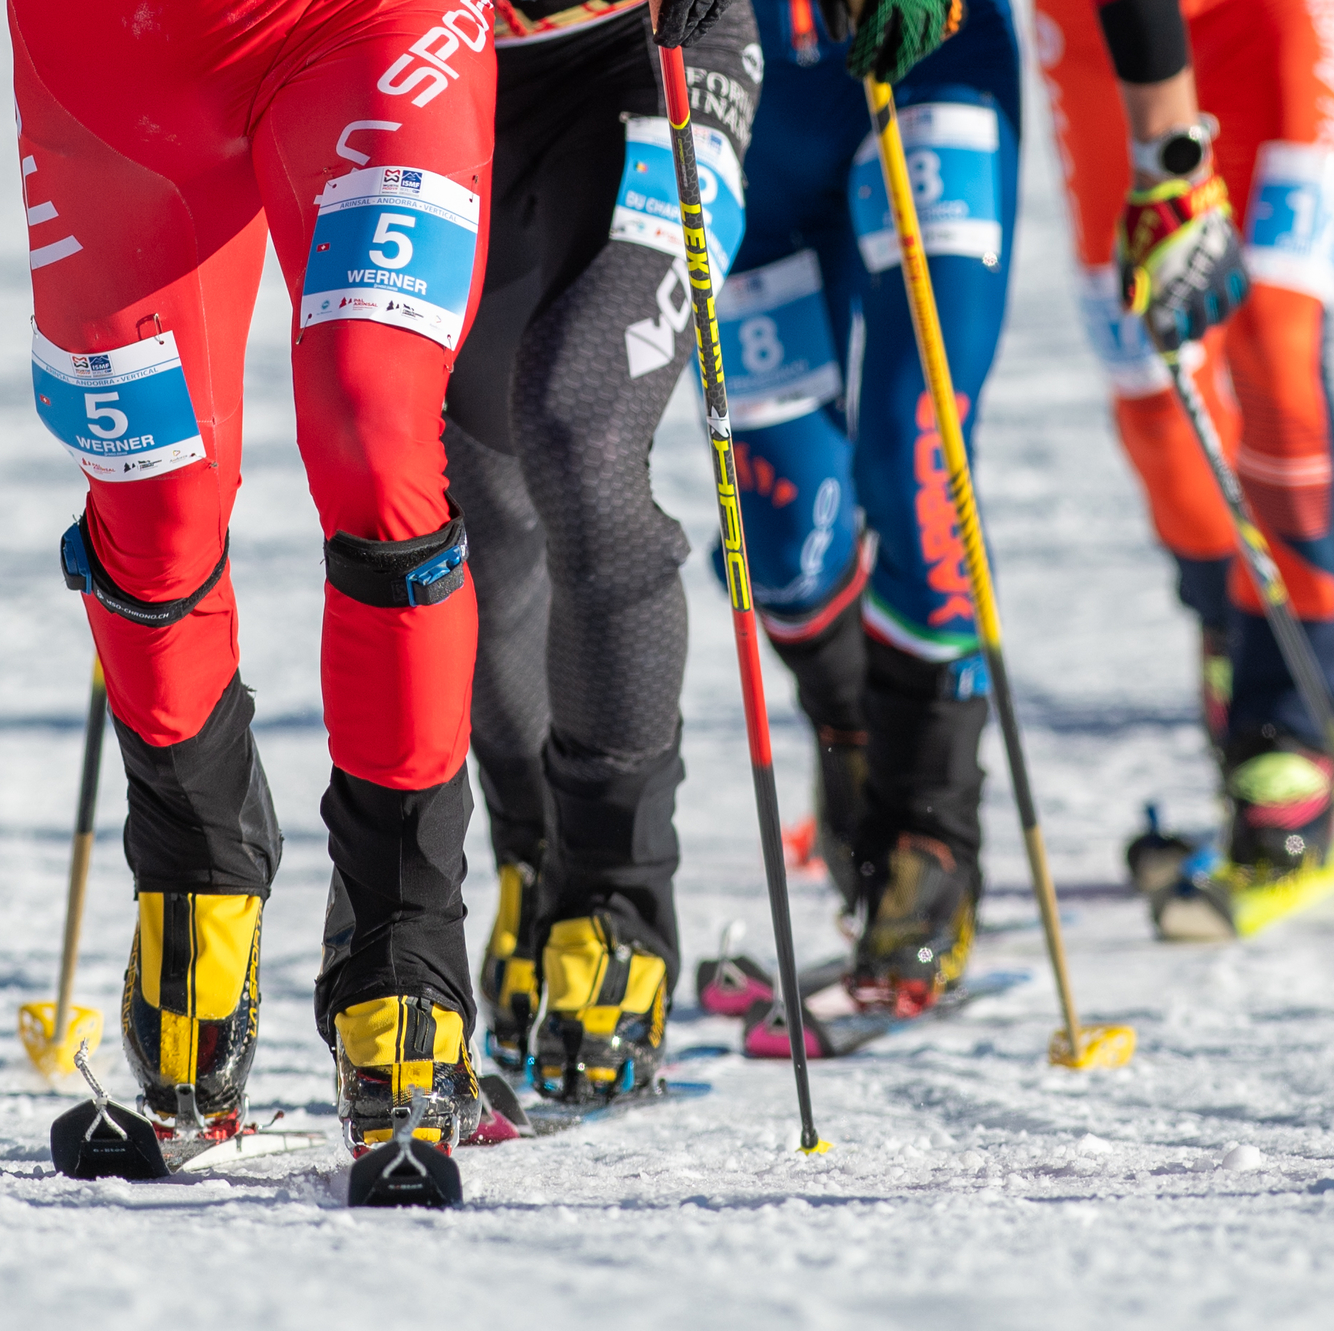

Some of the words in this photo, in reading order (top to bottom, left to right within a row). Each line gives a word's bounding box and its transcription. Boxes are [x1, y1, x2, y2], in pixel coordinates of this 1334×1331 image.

[402, 180, 421, 188] ISMF
[339, 197, 371, 209] ARINSAL
[377, 197, 418, 208] ANDORRA
[424, 205, 457, 222] VERTICAL
[368, 212, 416, 270] 5
[679, 202, 711, 290] LEKI
[347, 269, 428, 296] WERNER
[739, 316, 784, 372] 8
[75, 378, 115, 386] ANDORRA
[120, 367, 158, 382] VERTICAL
[84, 391, 129, 439] 5
[75, 434, 155, 452] WERNER
